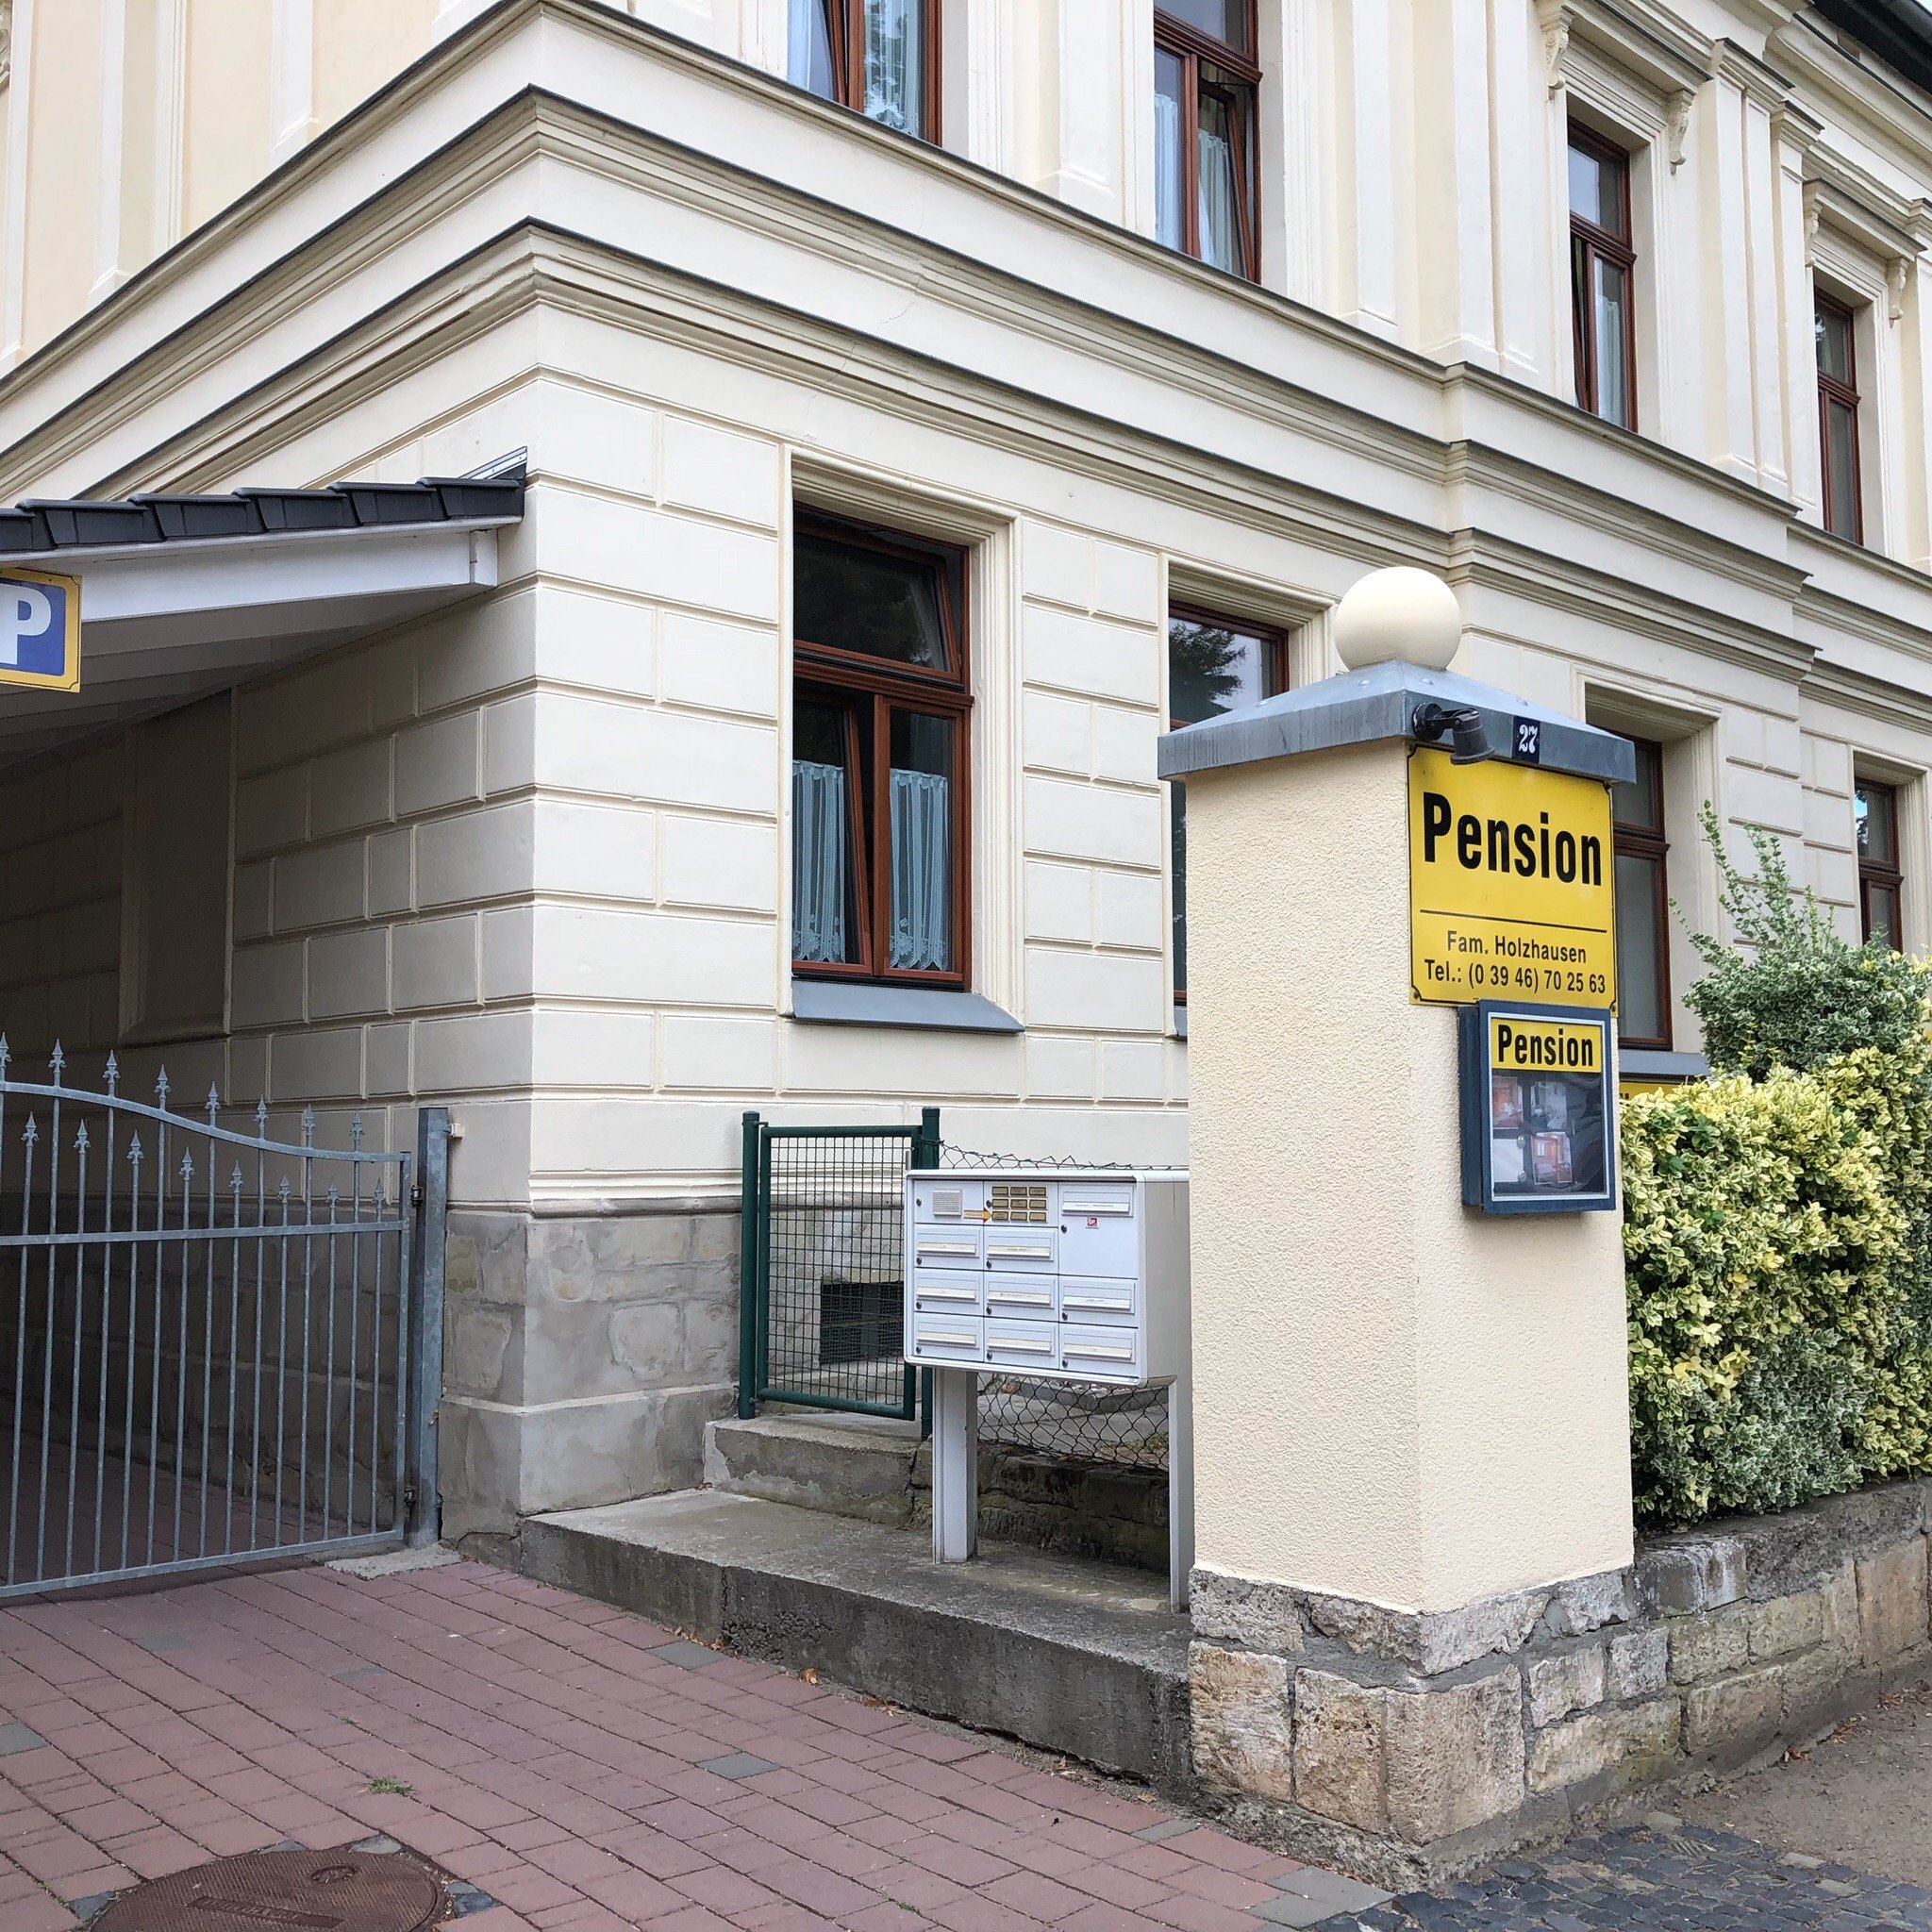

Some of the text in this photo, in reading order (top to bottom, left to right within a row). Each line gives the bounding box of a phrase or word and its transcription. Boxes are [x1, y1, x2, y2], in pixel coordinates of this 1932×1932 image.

[0, 582, 51, 665] P
[1519, 724, 1538, 754] 27
[1423, 791, 1602, 887] Pension
[1447, 930, 1587, 963] Fam. Holzhausen
[1424, 958, 1606, 993] Tel.: (0 39 46) 70 25 63
[1498, 1024, 1593, 1067] Pension
